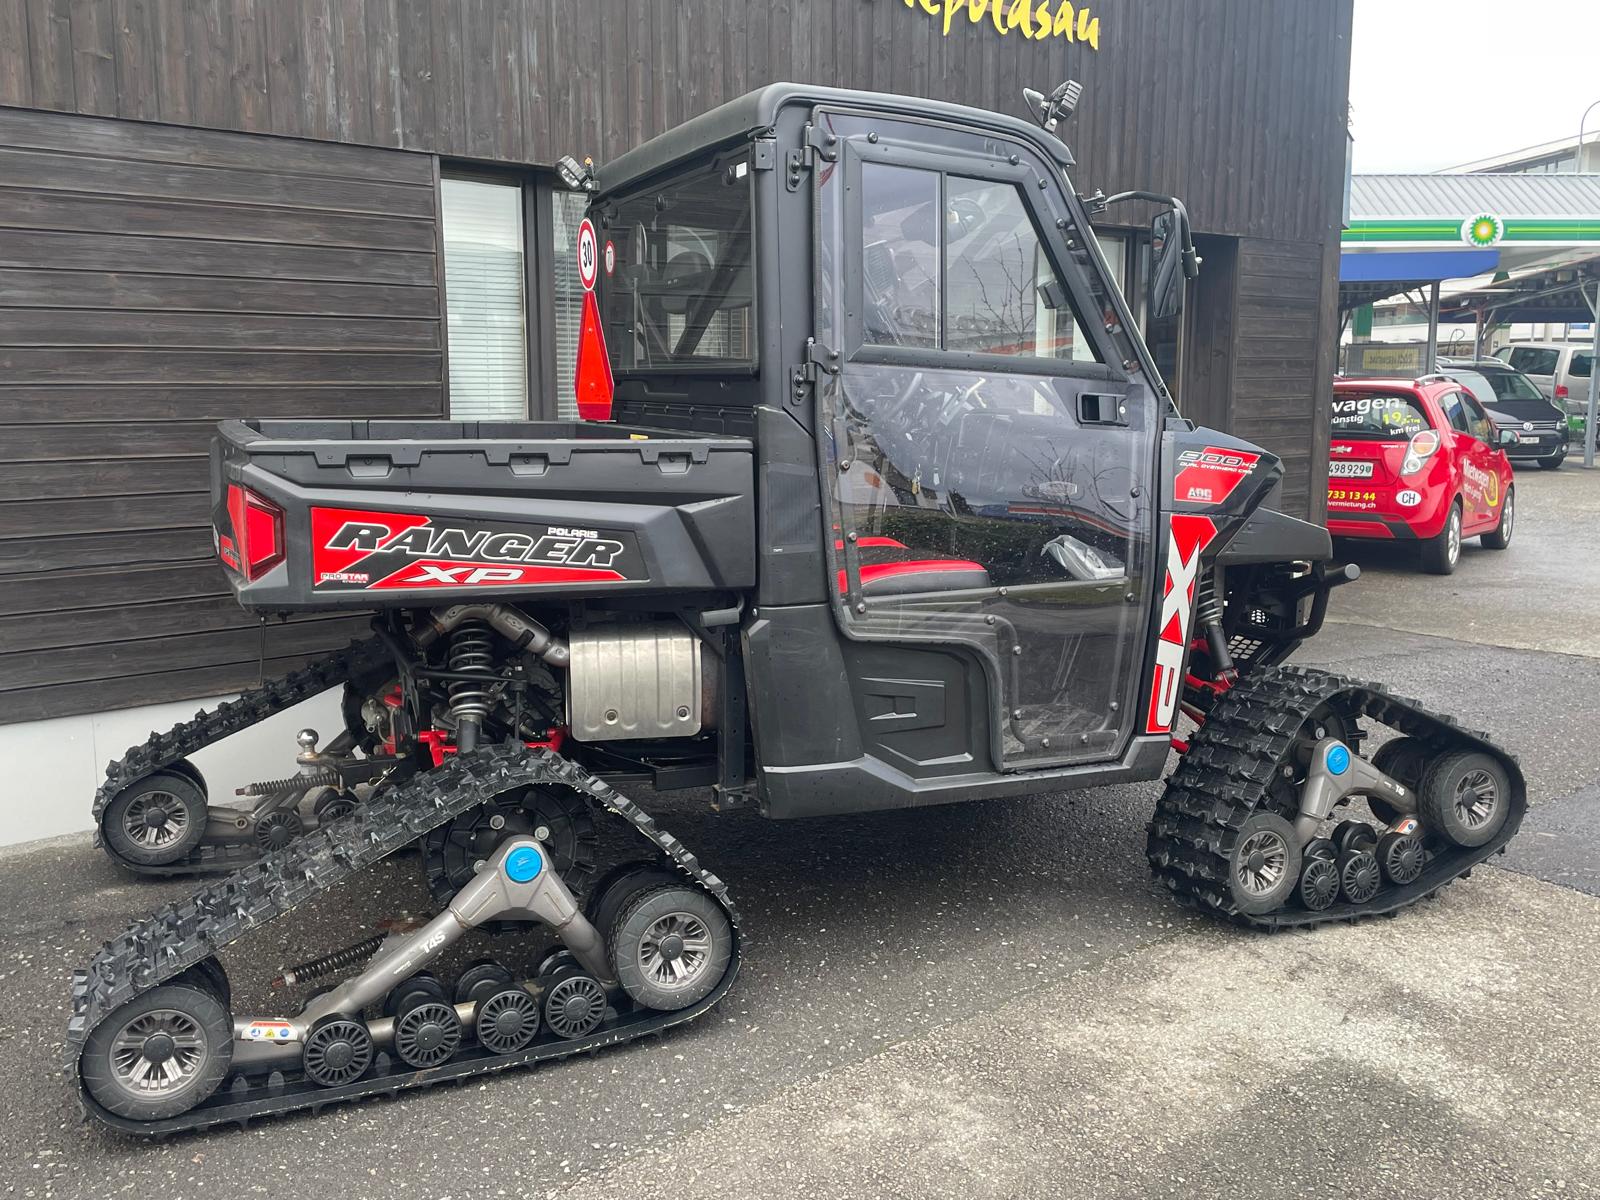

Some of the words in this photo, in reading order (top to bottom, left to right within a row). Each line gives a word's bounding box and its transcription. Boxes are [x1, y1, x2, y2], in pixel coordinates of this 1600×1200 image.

[583, 240, 593, 268] 30
[1177, 451, 1243, 467] 900
[1349, 491, 1361, 500] 13
[1363, 492, 1377, 501] 44
[1402, 492, 1416, 505] CH
[1328, 501, 1377, 510] vermietung.ch
[547, 527, 598, 538] POLARIS
[324, 521, 624, 568] RANGER
[320, 572, 369, 581] PROSTAR
[402, 565, 523, 584] XP
[423, 931, 446, 953] T4S
